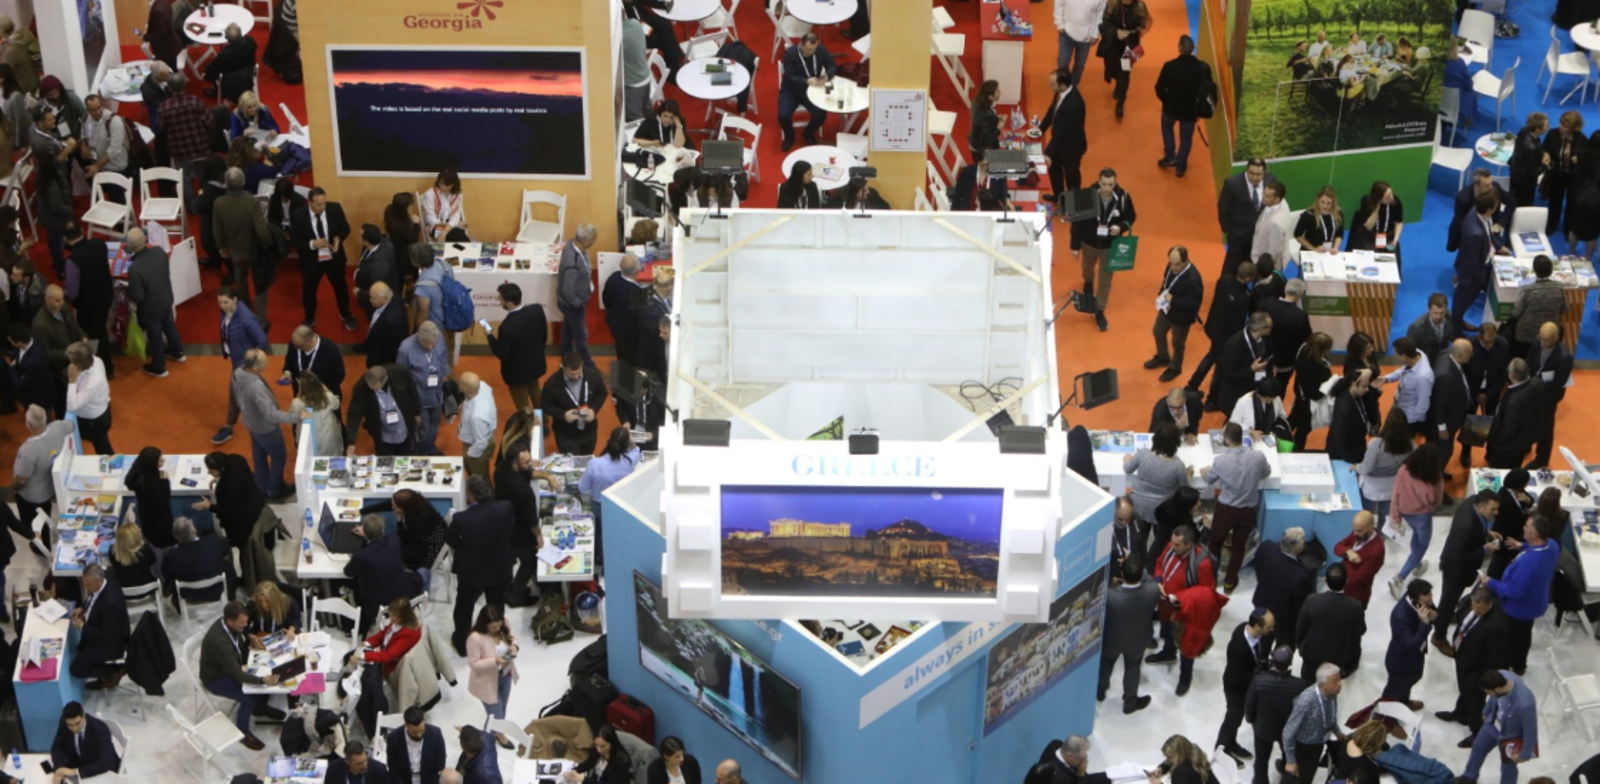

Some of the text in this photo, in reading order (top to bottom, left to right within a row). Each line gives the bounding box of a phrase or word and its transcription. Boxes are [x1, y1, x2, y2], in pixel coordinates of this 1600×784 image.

[403, 15, 483, 32] Georgia
[370, 104, 381, 112] The
[505, 107, 513, 115] by
[790, 454, 935, 477] GREECE
[903, 640, 963, 690] always
[967, 627, 983, 646] in
